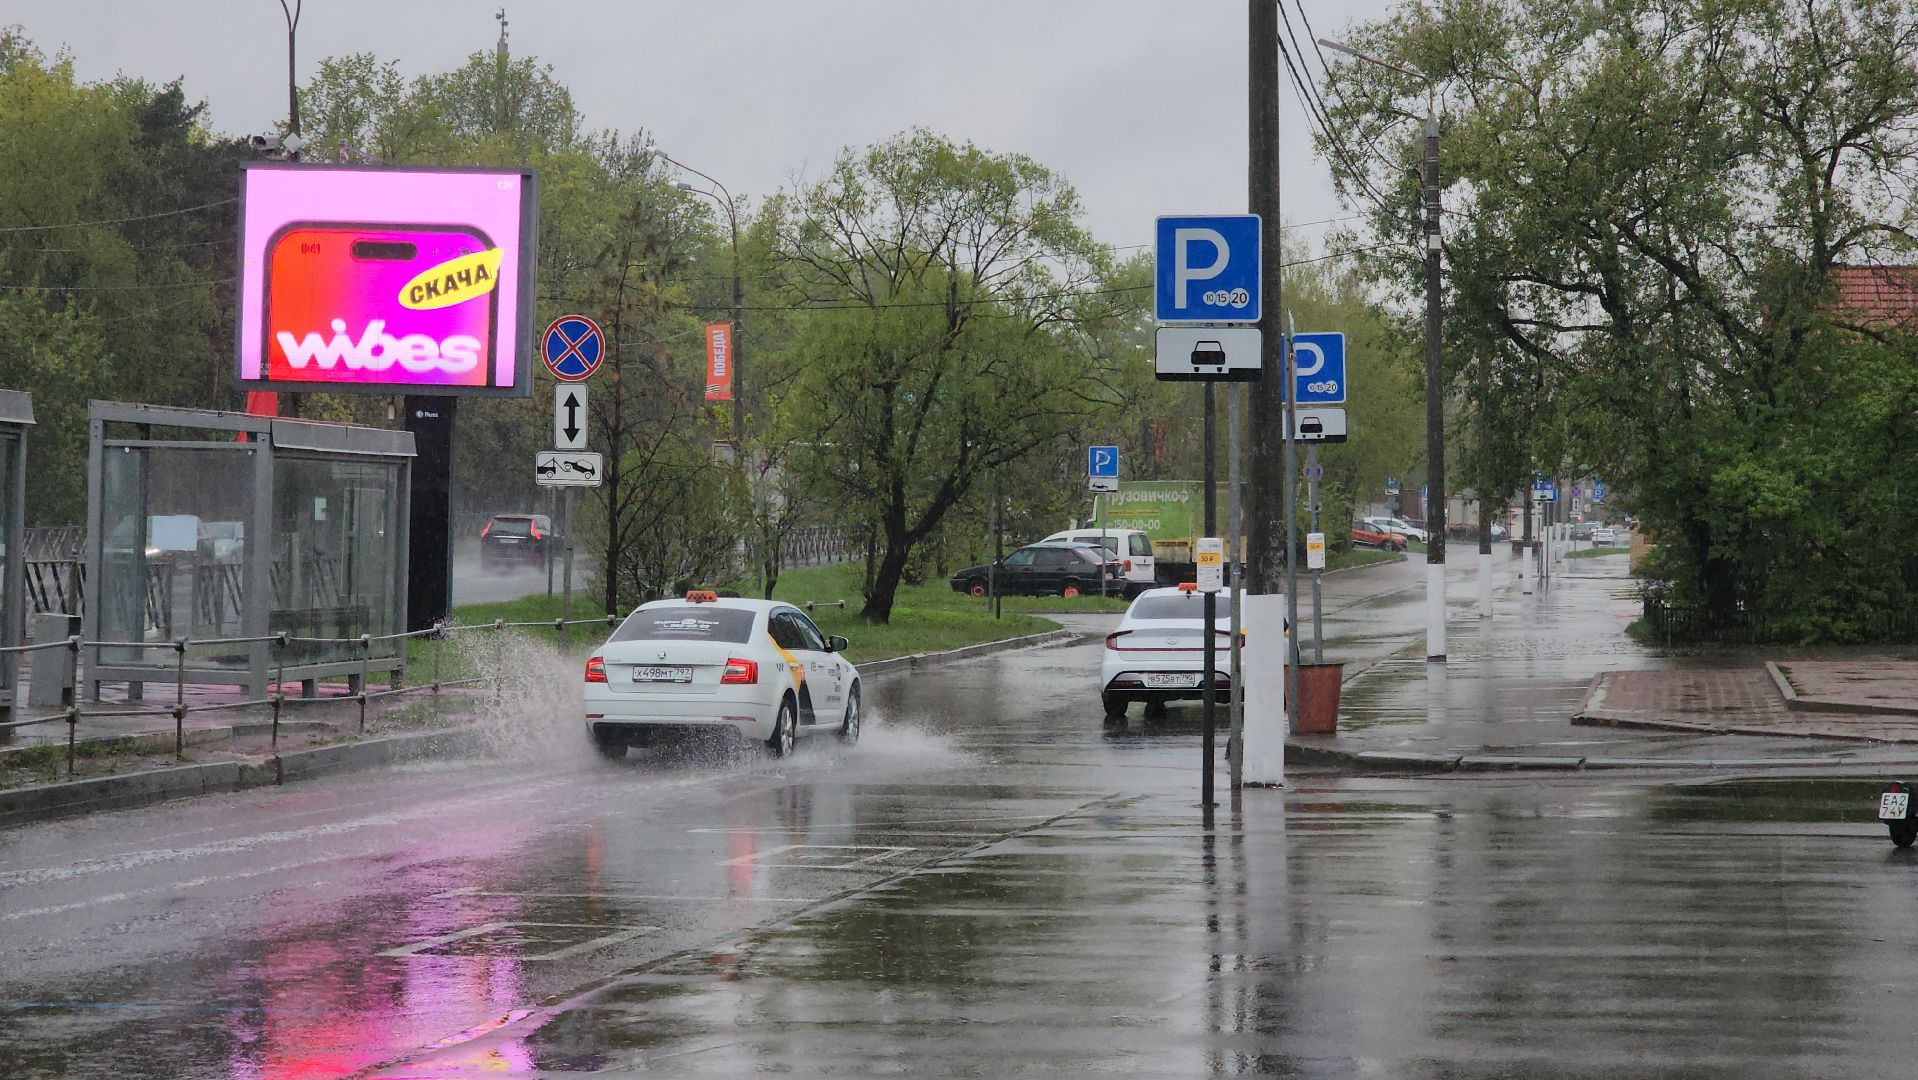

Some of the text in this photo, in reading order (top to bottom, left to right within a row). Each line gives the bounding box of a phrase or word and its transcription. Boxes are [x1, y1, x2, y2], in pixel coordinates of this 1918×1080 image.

[409, 264, 490, 304] СКАЧА
[1174, 228, 1230, 309] P
[1217, 293, 1227, 303] 15
[1231, 292, 1247, 304] 20
[276, 318, 482, 374] wibes
[1095, 450, 1111, 473] P
